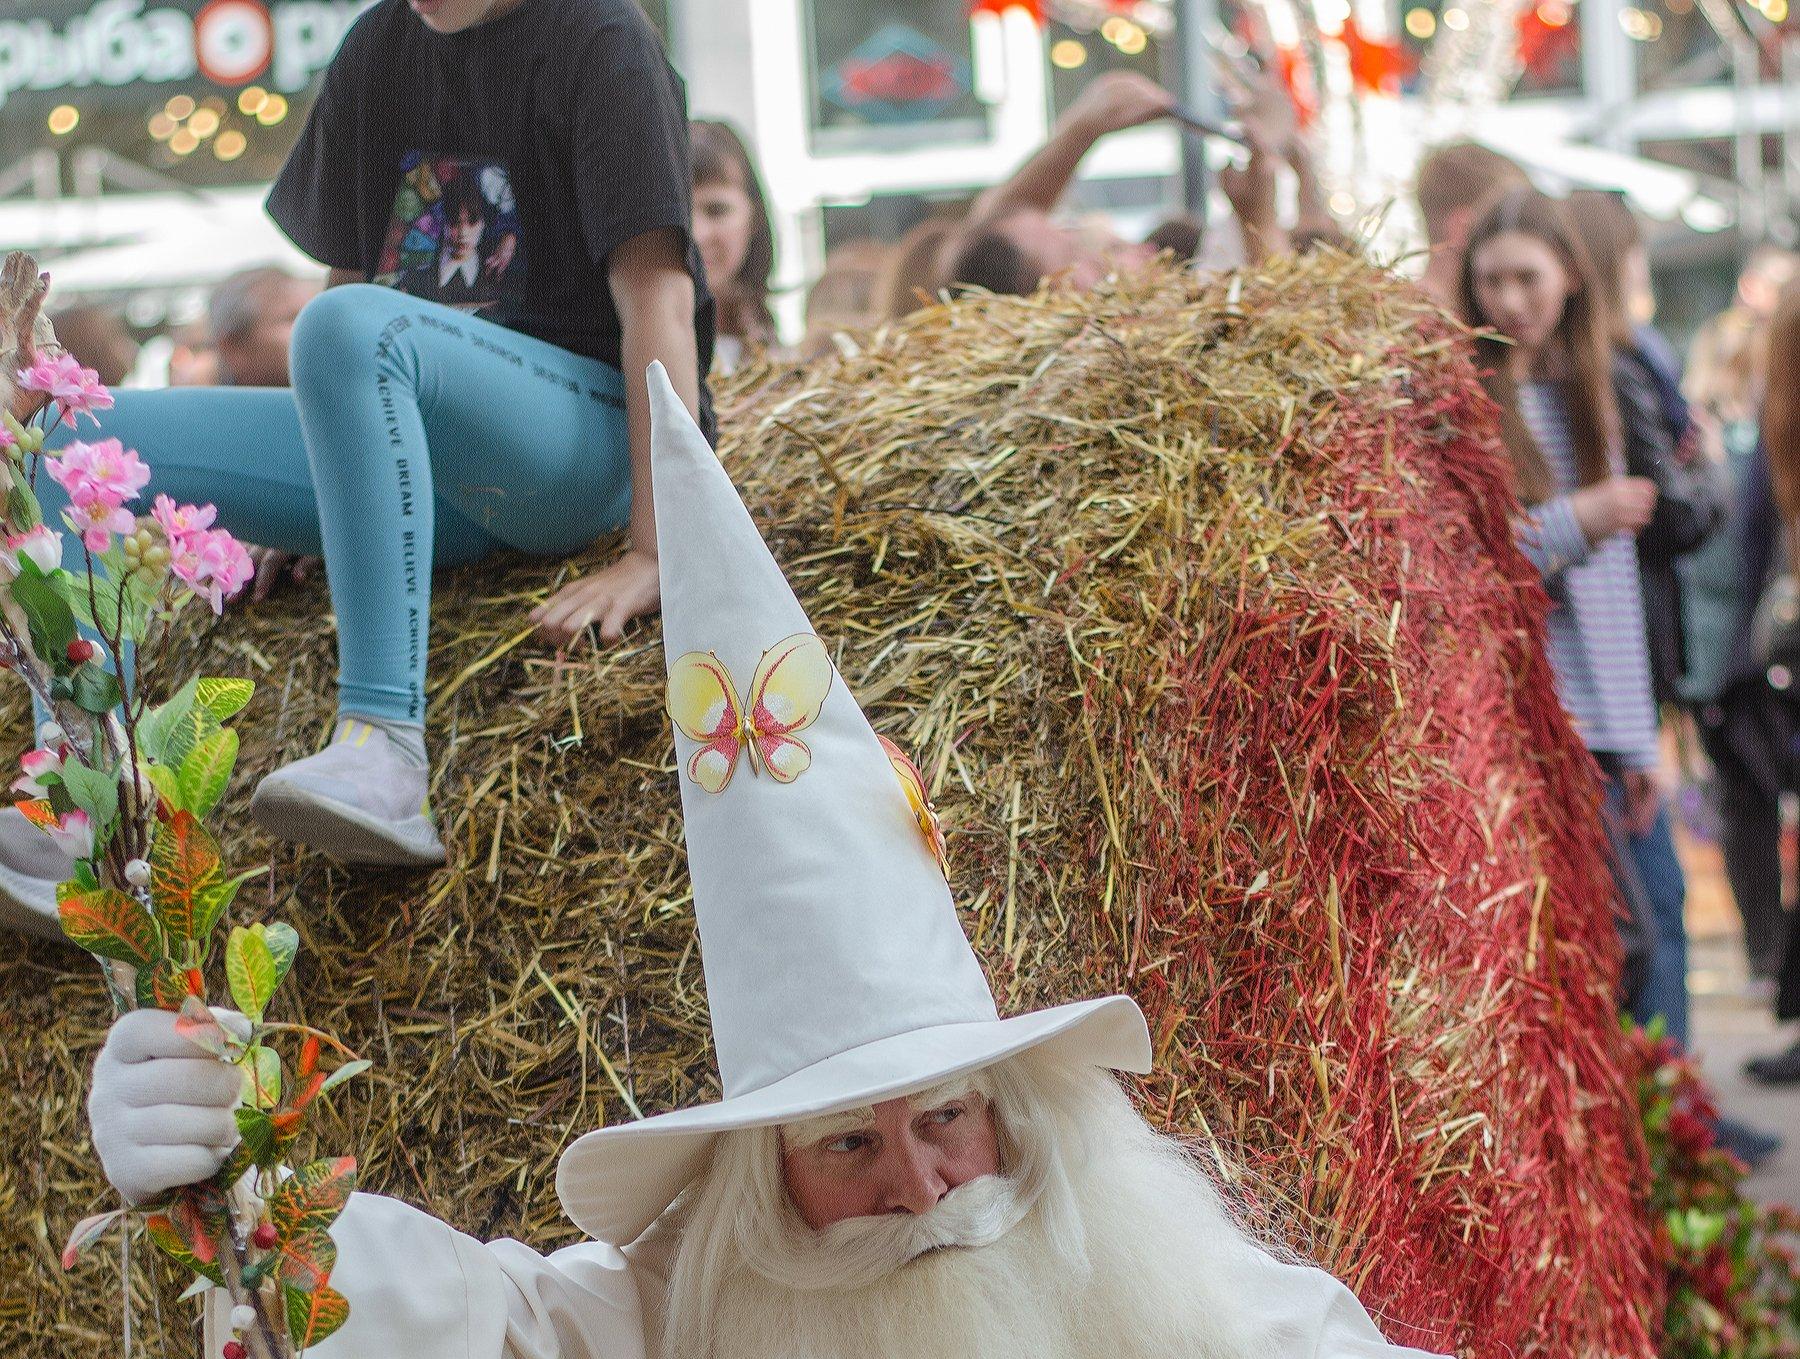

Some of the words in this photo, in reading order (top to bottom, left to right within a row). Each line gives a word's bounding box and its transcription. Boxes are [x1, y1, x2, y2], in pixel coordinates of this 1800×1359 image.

[377, 373, 402, 447] ACHIEVE
[396, 458, 414, 518] DREAM
[404, 531, 415, 597] BELIEVE
